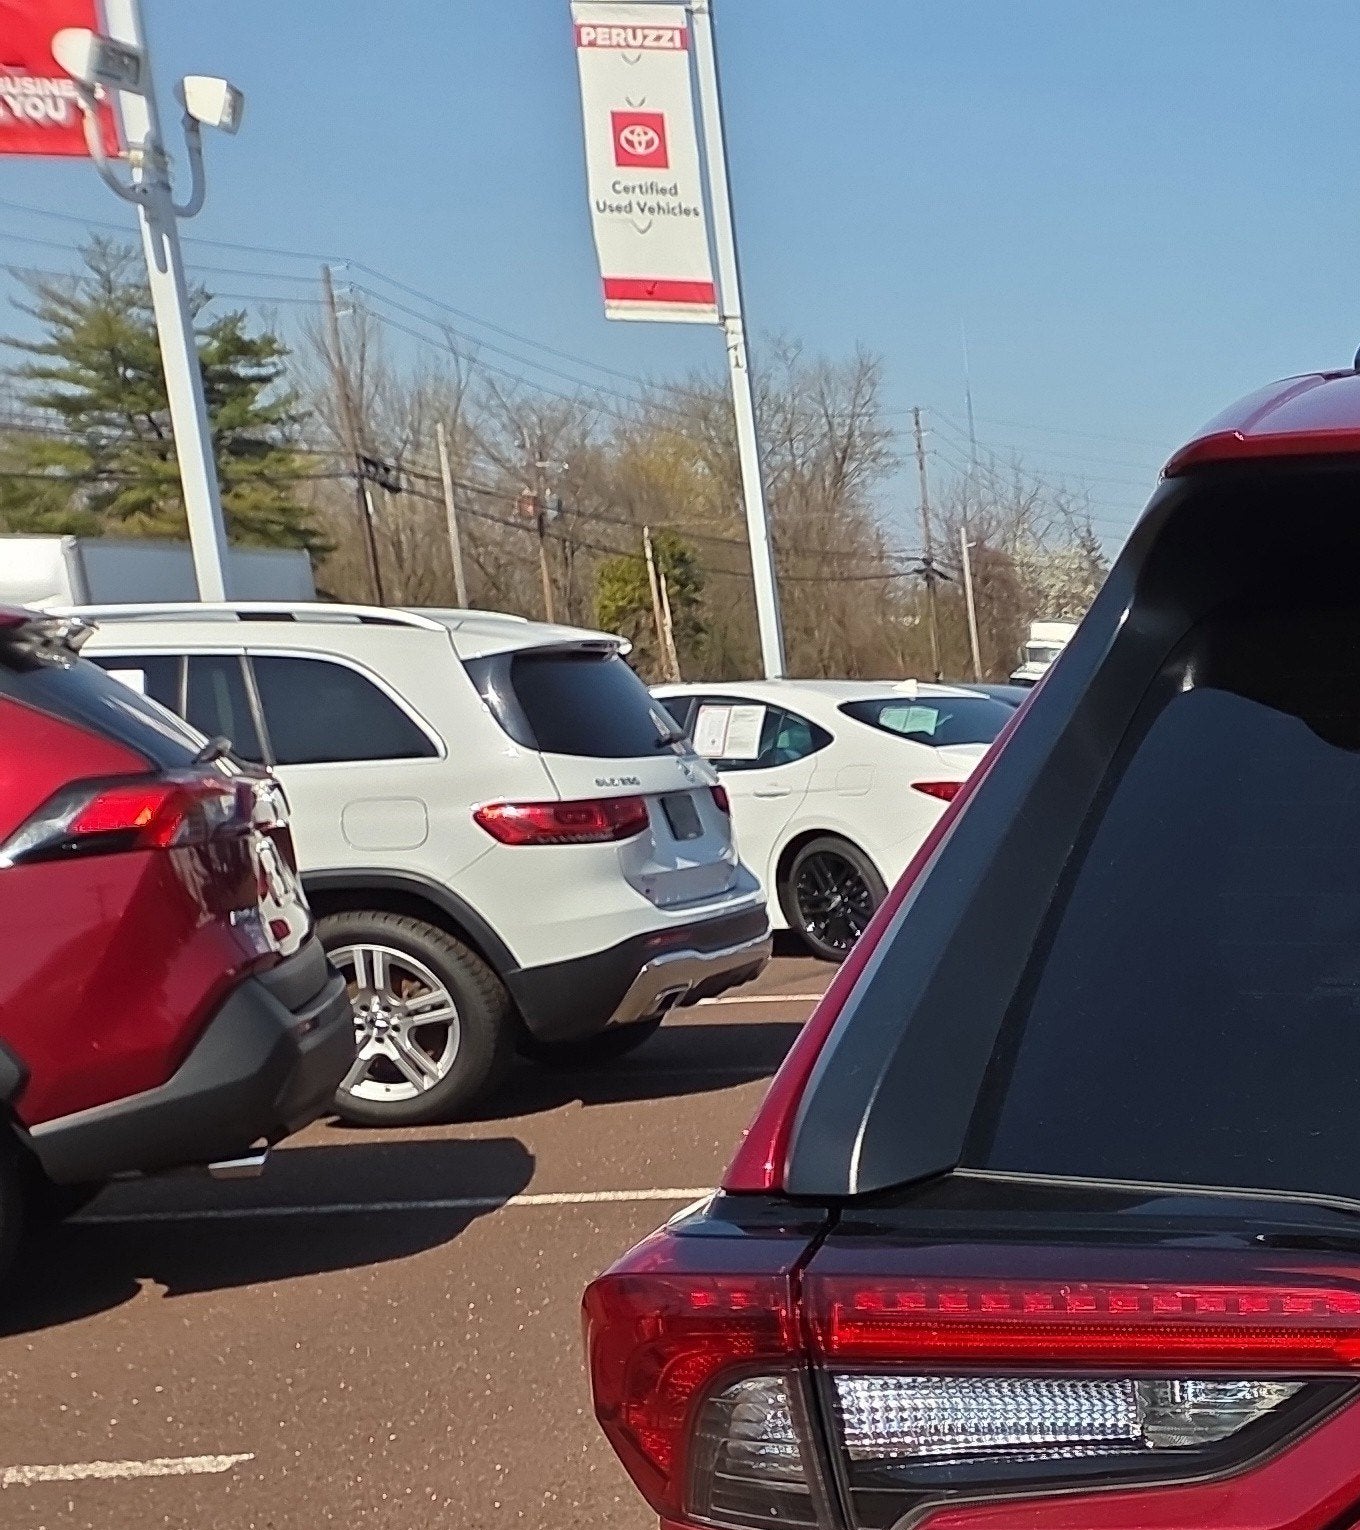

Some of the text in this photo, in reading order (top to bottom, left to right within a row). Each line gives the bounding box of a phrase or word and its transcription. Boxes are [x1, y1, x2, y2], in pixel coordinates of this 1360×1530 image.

[580, 26, 681, 49] PERUZZI
[1, 92, 67, 121] YOU
[612, 180, 678, 197] Certified
[596, 199, 699, 217] Used Vehicles
